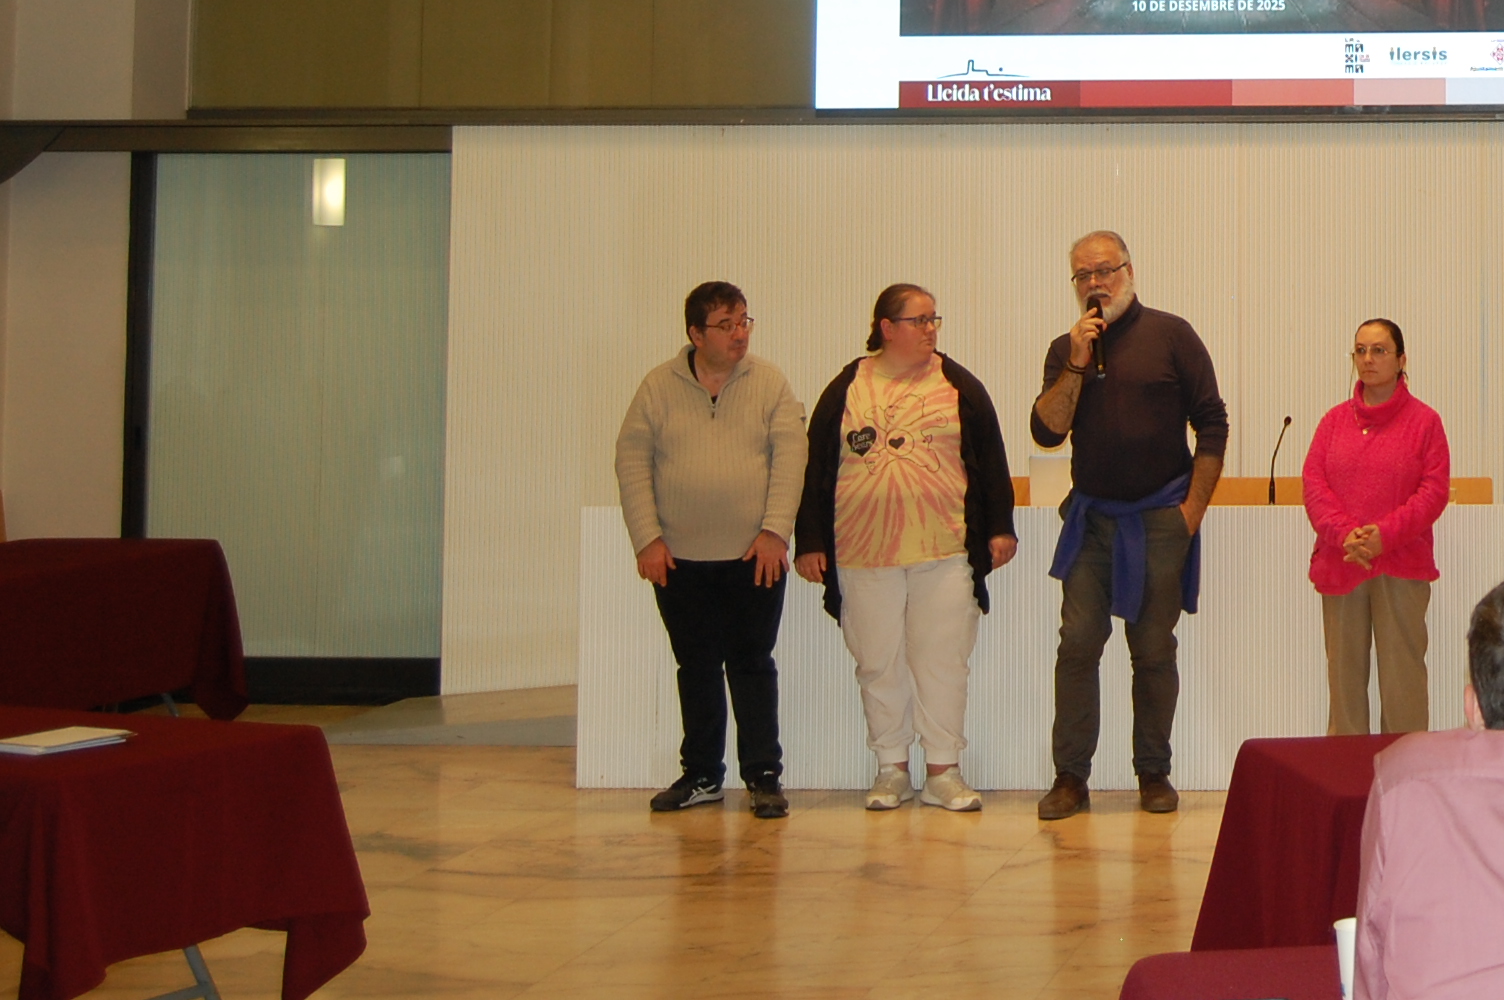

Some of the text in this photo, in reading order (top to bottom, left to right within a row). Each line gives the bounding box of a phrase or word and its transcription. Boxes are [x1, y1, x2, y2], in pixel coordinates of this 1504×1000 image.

[1132, 0, 1286, 12] 10 DE DESEMBRE DE 2025
[927, 84, 980, 102] Lleida
